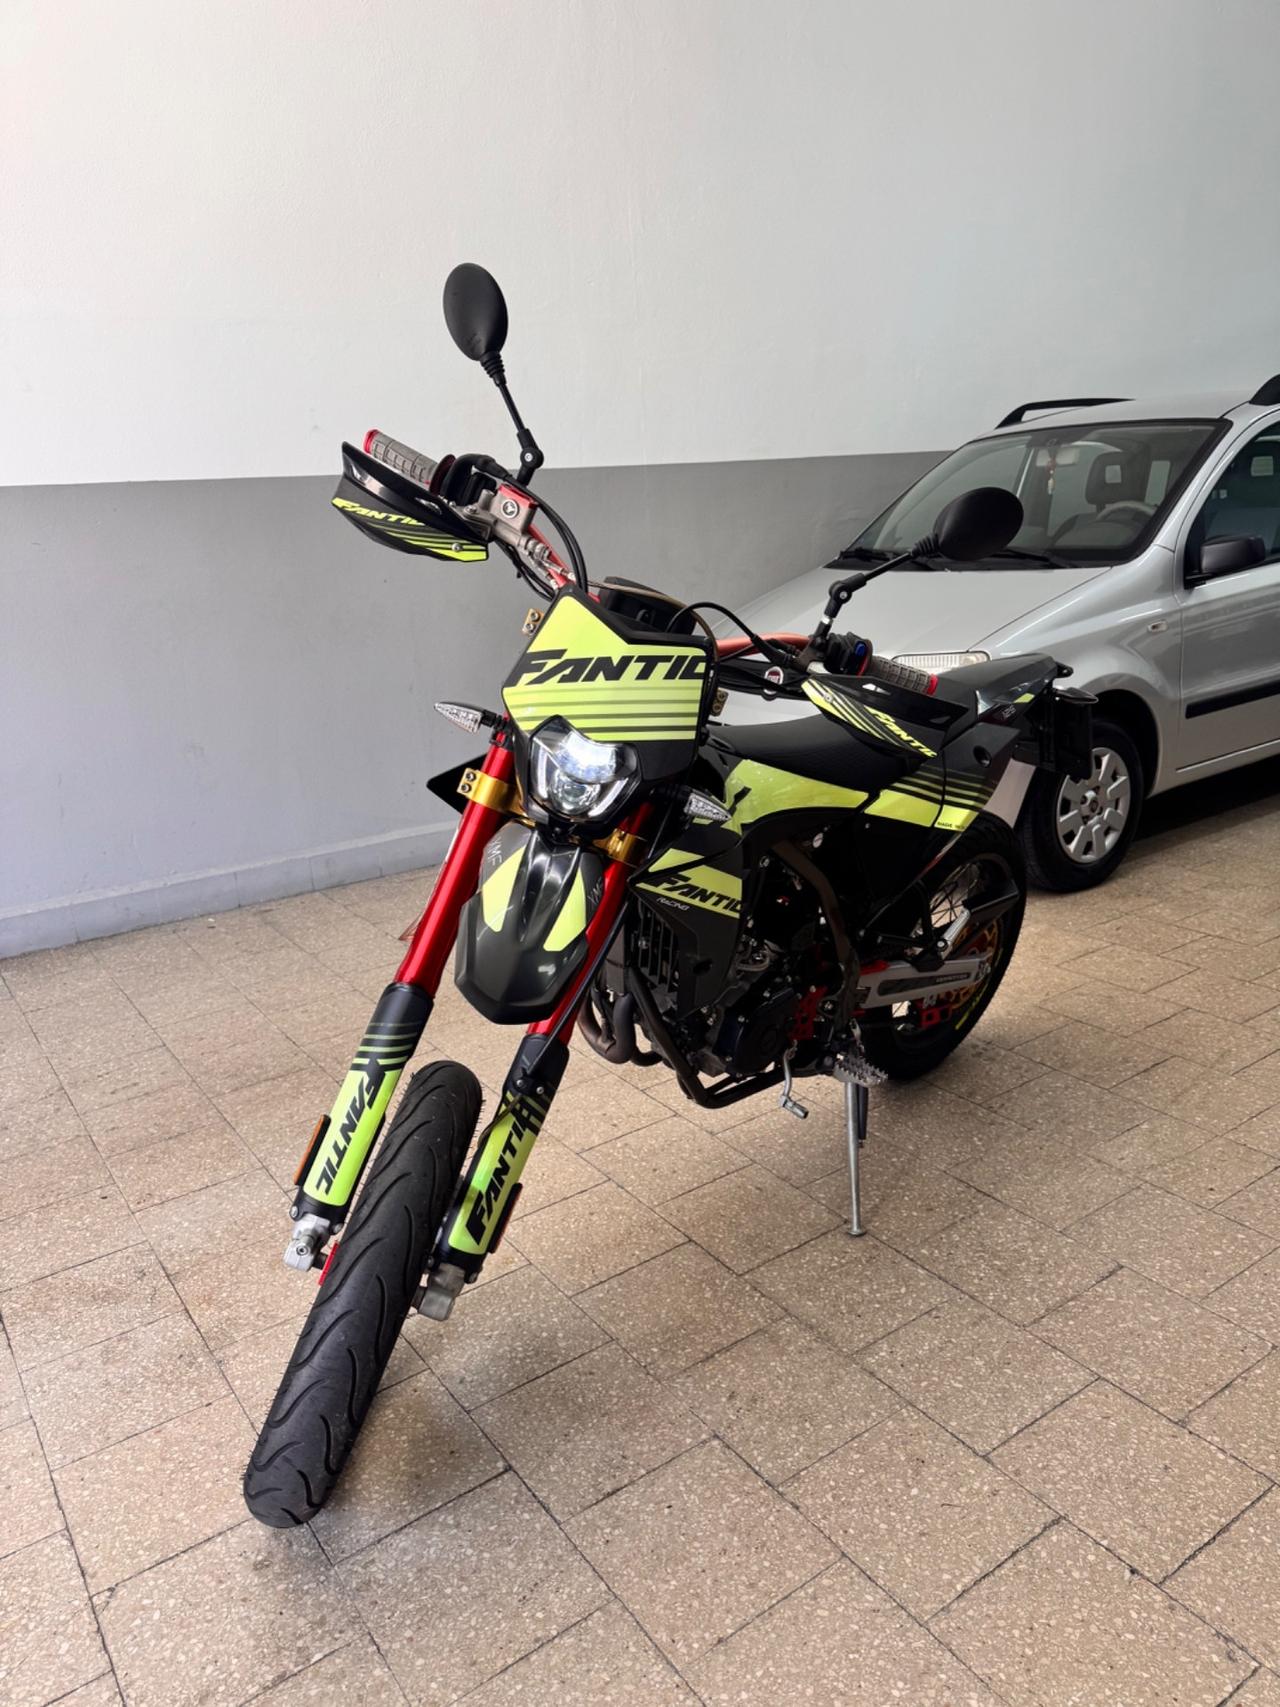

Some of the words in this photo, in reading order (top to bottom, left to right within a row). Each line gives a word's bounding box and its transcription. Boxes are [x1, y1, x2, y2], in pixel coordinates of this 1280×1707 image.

[504, 649, 706, 688] FANTIC
[642, 873, 742, 913] FANTIC
[315, 1057, 387, 1196] FANTIC
